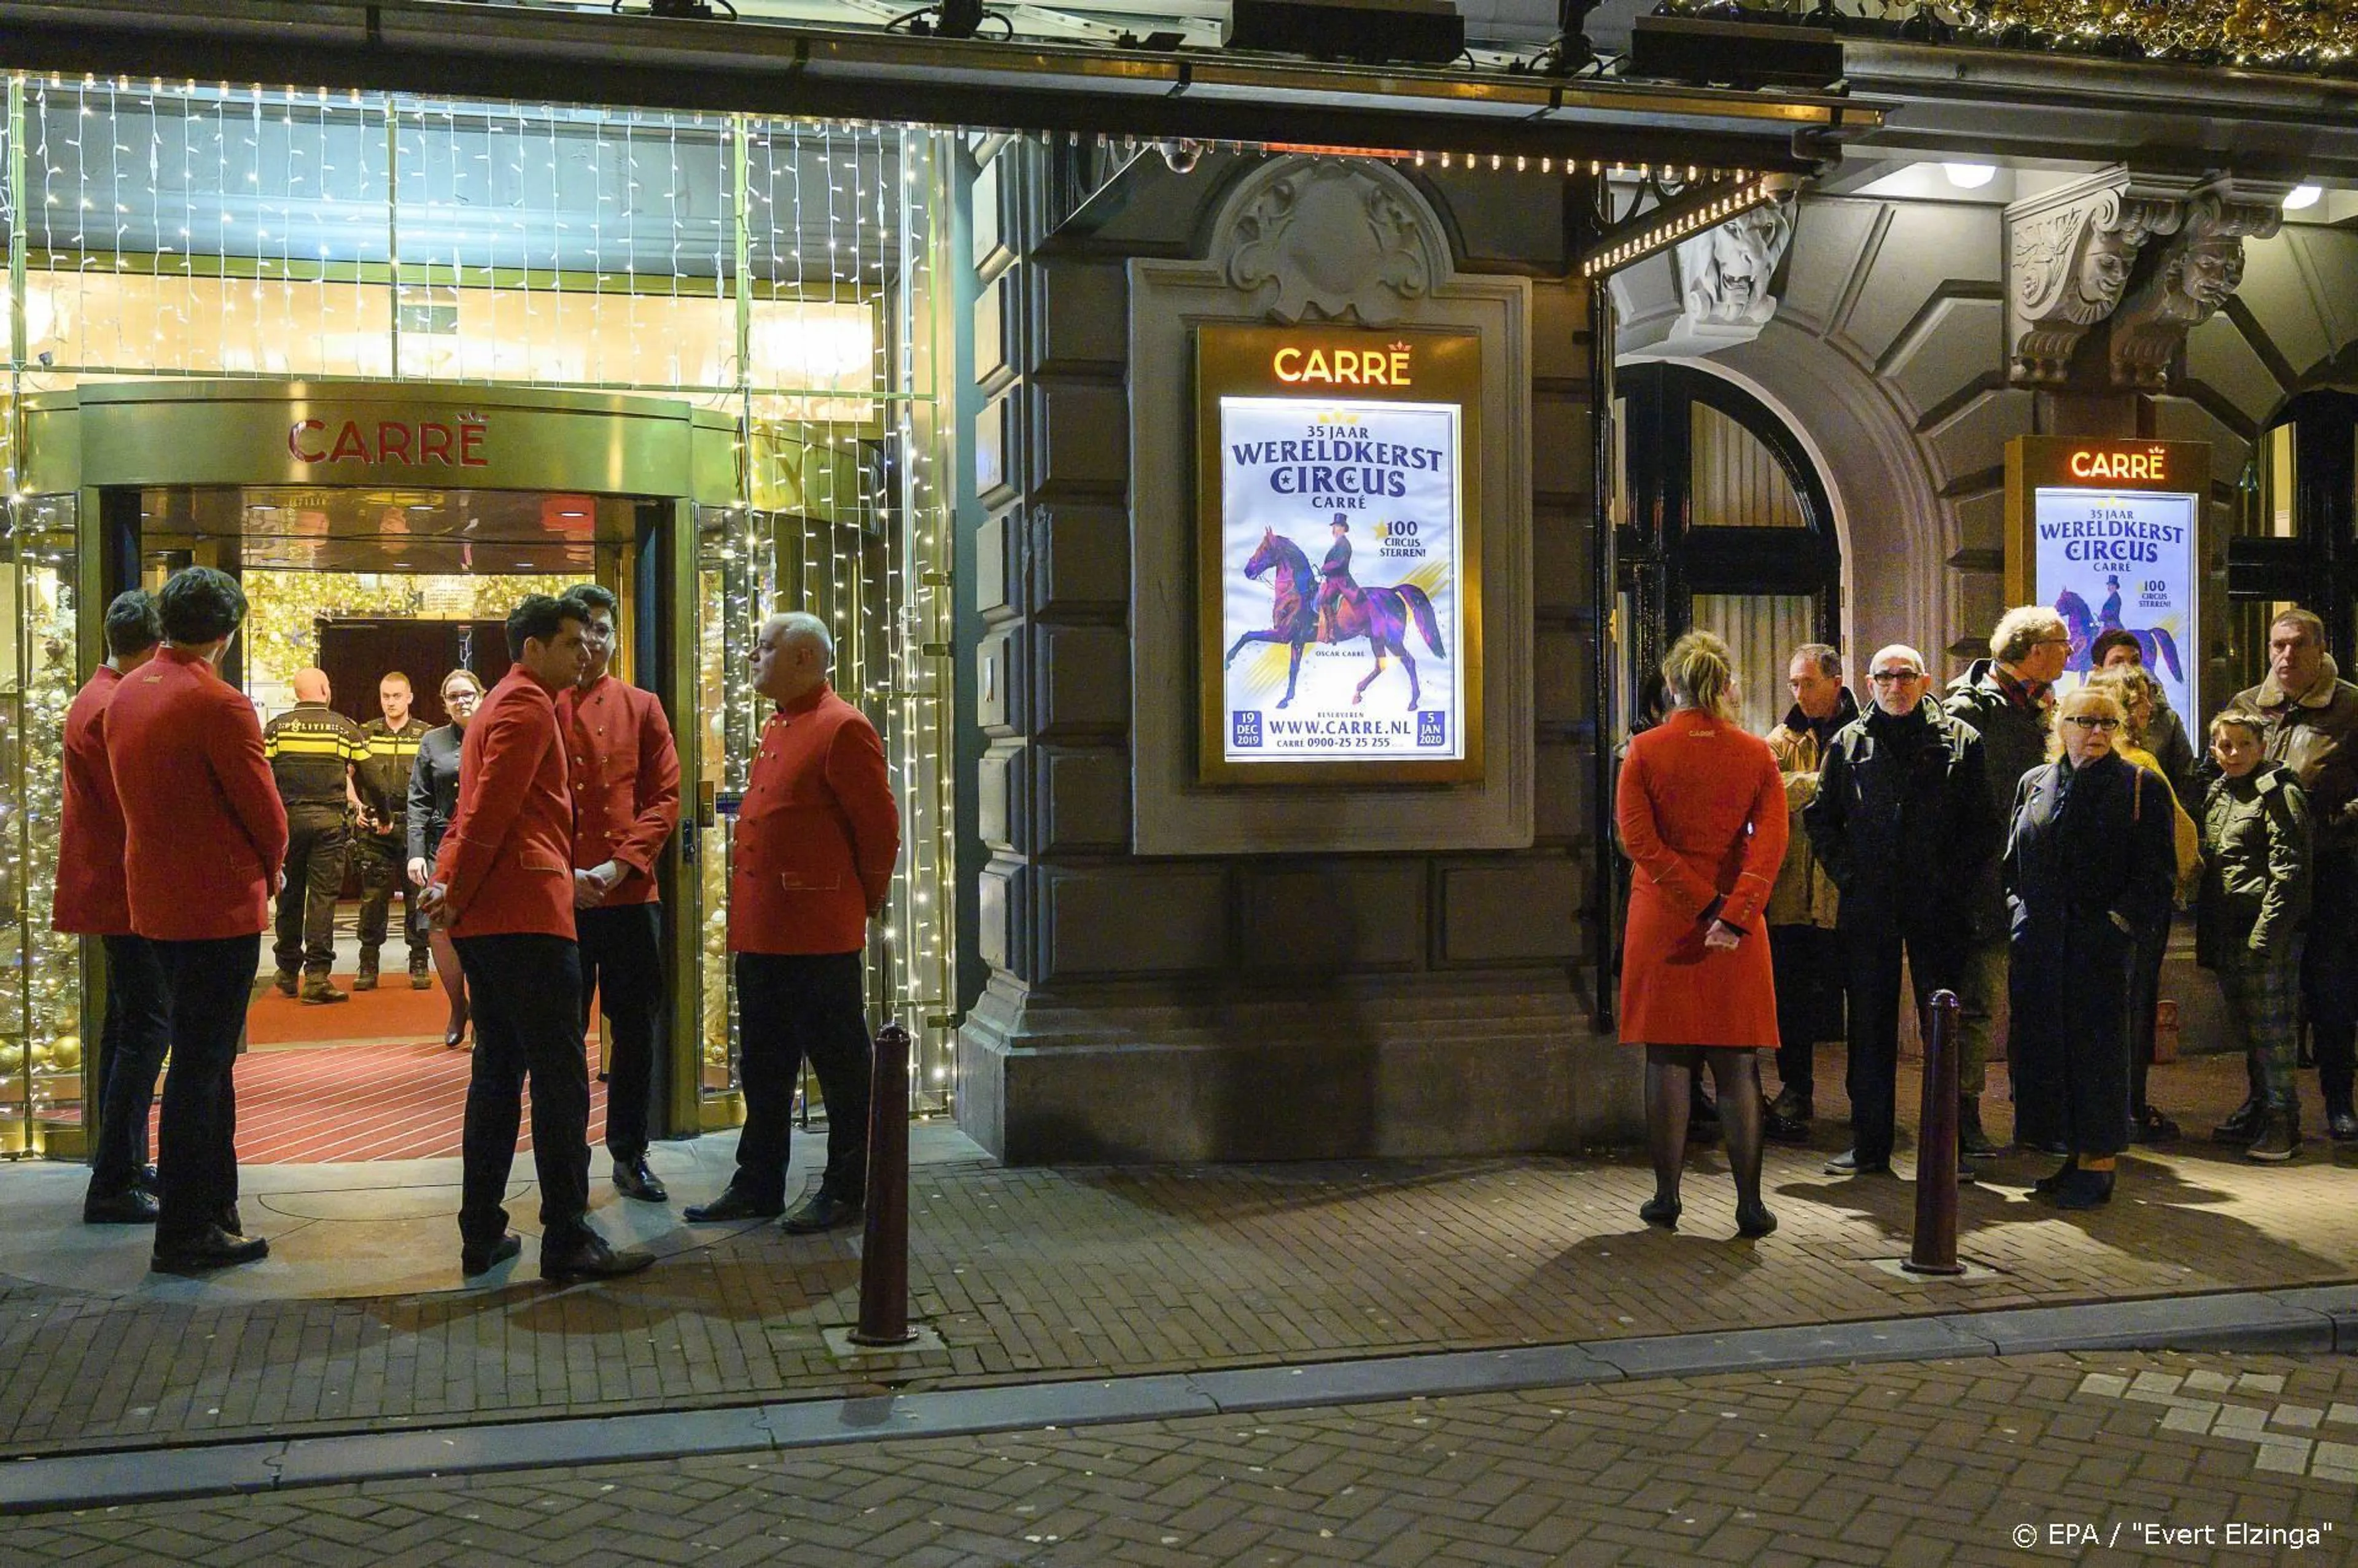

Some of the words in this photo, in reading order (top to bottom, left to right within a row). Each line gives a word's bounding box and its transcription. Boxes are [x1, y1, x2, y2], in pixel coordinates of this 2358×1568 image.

[1307, 425, 1325, 437] 35
[1330, 426, 1369, 440] JAAR
[1232, 440, 1443, 472] WERELDKERST
[1269, 466, 1406, 498] CIRCUS
[1312, 495, 1367, 510] CARRÉ
[2090, 509, 2103, 519] 35
[2106, 510, 2133, 521] JAAR
[1387, 520, 1418, 536] 100
[2040, 521, 2184, 543] WERELDKERST
[1384, 537, 1421, 547] CIRCUS
[1380, 548, 1426, 557] STERREN!
[2064, 540, 2158, 563] CIRCUS
[2093, 561, 2132, 572] CARRÉ
[2144, 580, 2166, 591] 100
[1241, 712, 1255, 723] 19
[1426, 712, 1435, 723] 5
[1237, 724, 1258, 734] DEC
[1269, 720, 1411, 735] WWW.CARRE.NL
[1421, 724, 1441, 734] JAN
[1237, 735, 1258, 744] 2019
[1307, 737, 1351, 748] 0900-25
[1355, 737, 1368, 747] 25
[1371, 737, 1390, 747] 255
[1419, 735, 1442, 744] 2020
